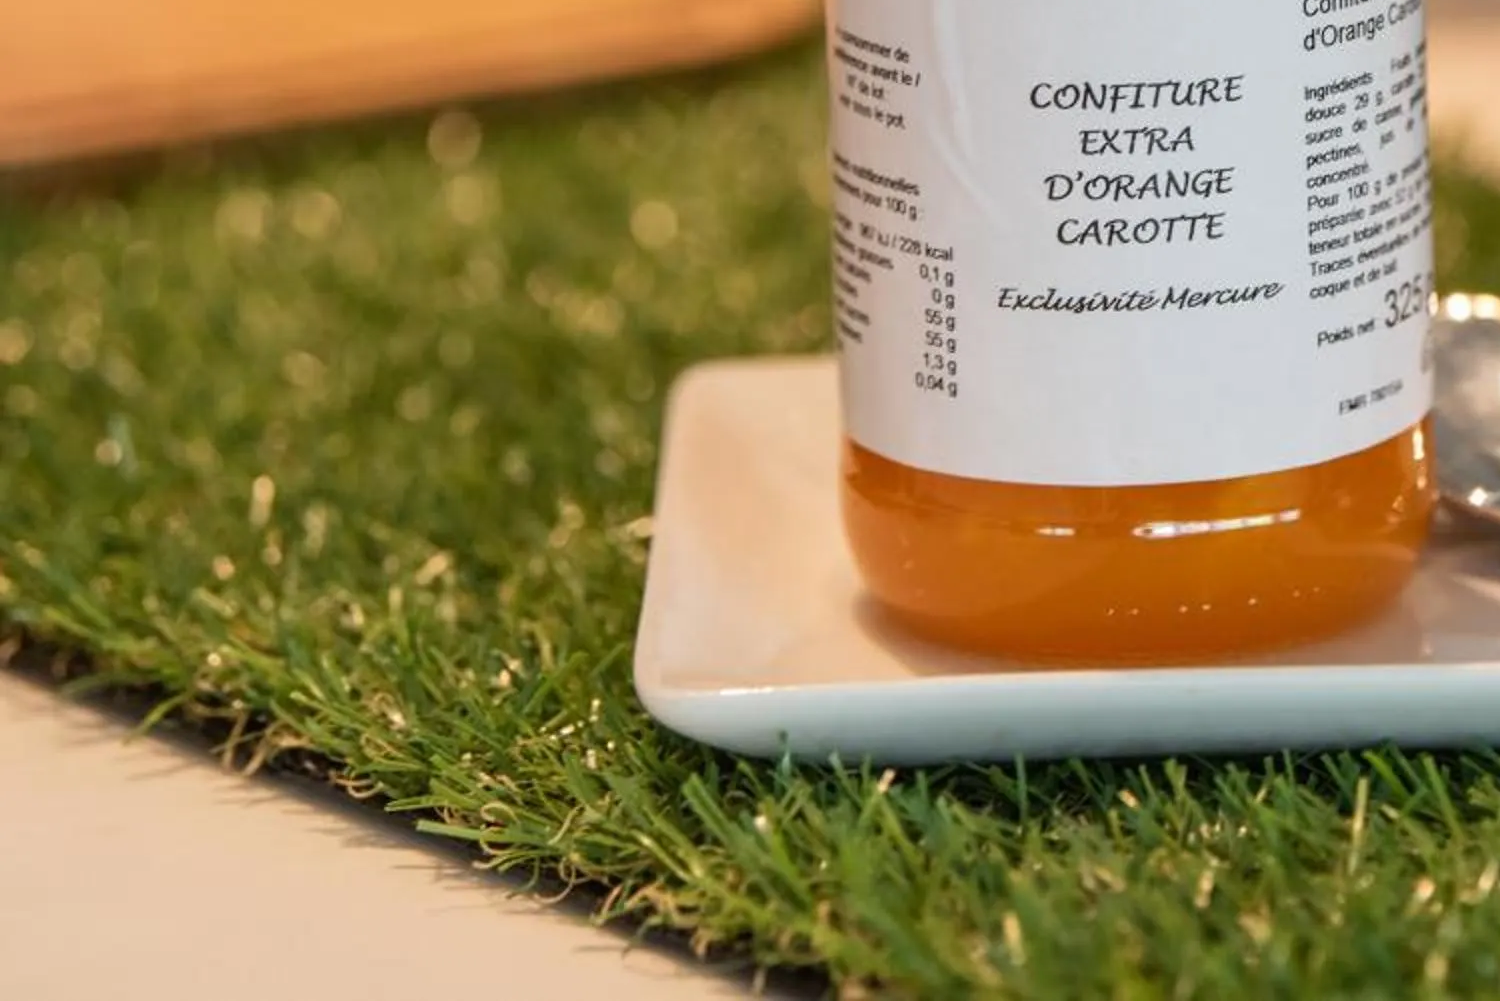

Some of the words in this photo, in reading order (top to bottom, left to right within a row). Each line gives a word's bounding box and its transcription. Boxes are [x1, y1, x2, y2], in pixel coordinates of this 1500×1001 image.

[1303, 13, 1384, 52] d'Orange
[901, 71, 913, 86] le
[1029, 74, 1245, 113] CONFITURE
[1305, 102, 1346, 123] douce
[1079, 126, 1195, 155] EXTRA
[1305, 125, 1343, 145] sucre
[1352, 118, 1367, 134] de
[1043, 167, 1236, 202] D'ORANGE
[1308, 193, 1340, 211] Pour
[1347, 180, 1368, 201] 100
[886, 196, 906, 215] 100
[1056, 212, 1227, 246] CAROTTE
[1308, 232, 1350, 256] teneur
[1353, 220, 1383, 243] totale
[924, 243, 953, 262] kcal
[1311, 254, 1354, 277] Traces
[944, 271, 954, 288] g
[1309, 277, 1351, 299] coque
[1368, 265, 1380, 282] de
[945, 293, 955, 310] g
[997, 286, 1158, 314] Exclusivité
[1160, 281, 1284, 310] Mercure
[945, 315, 955, 332] g
[1317, 326, 1354, 349] Poids
[1385, 274, 1422, 328] 325
[946, 338, 956, 354] g
[947, 360, 957, 376] g
[948, 381, 958, 399] g
